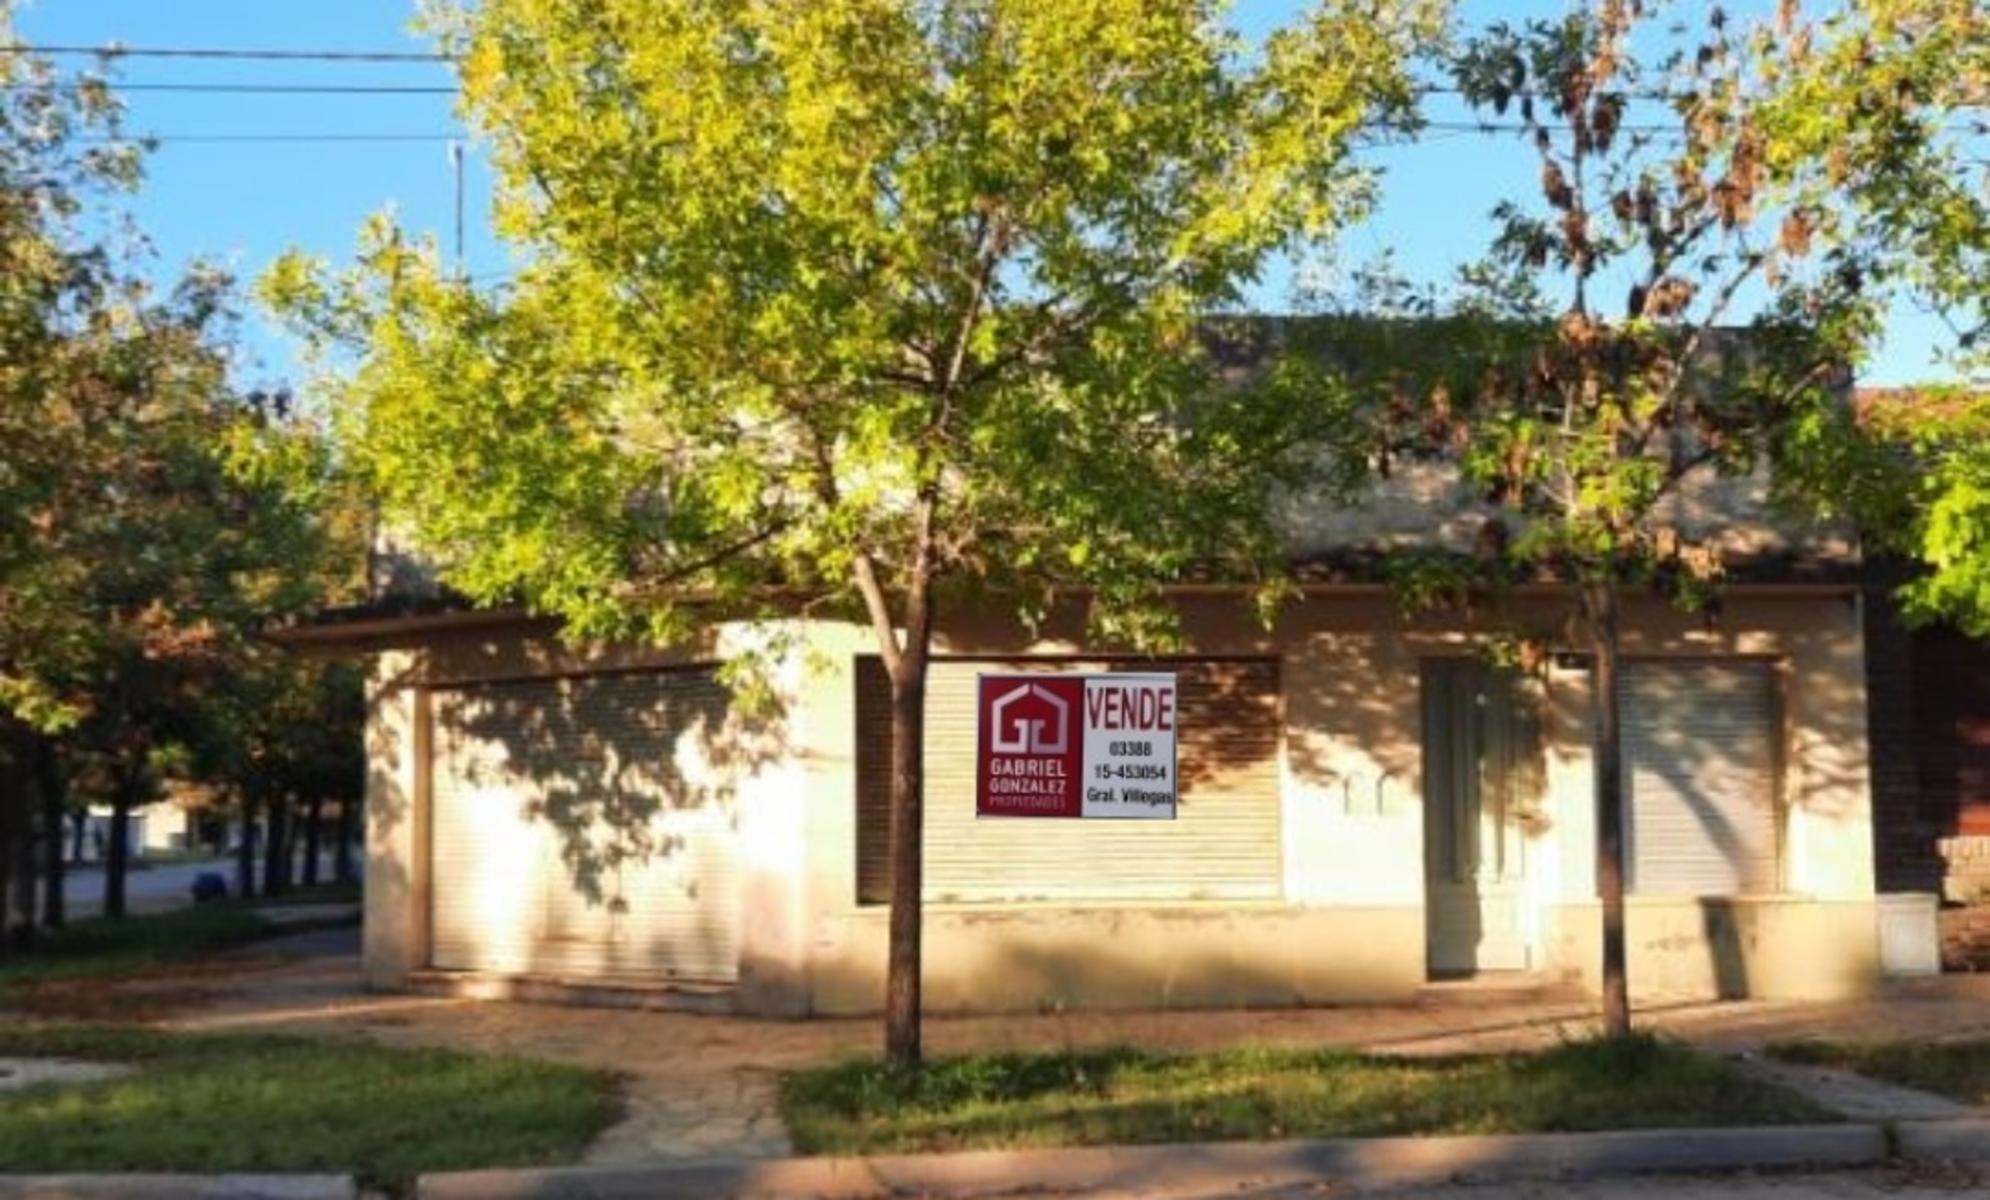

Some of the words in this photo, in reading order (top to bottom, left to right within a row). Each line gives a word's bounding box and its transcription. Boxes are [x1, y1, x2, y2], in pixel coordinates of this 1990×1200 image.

[1086, 687, 1173, 731] VENDE
[1109, 741, 1152, 756] 03388
[991, 758, 1067, 777] GABRIEL
[1095, 764, 1166, 779] 15-453054
[989, 778, 1066, 795] GONZALEZ
[1086, 787, 1118, 802] Gral.
[1121, 788, 1173, 806] Villegas
